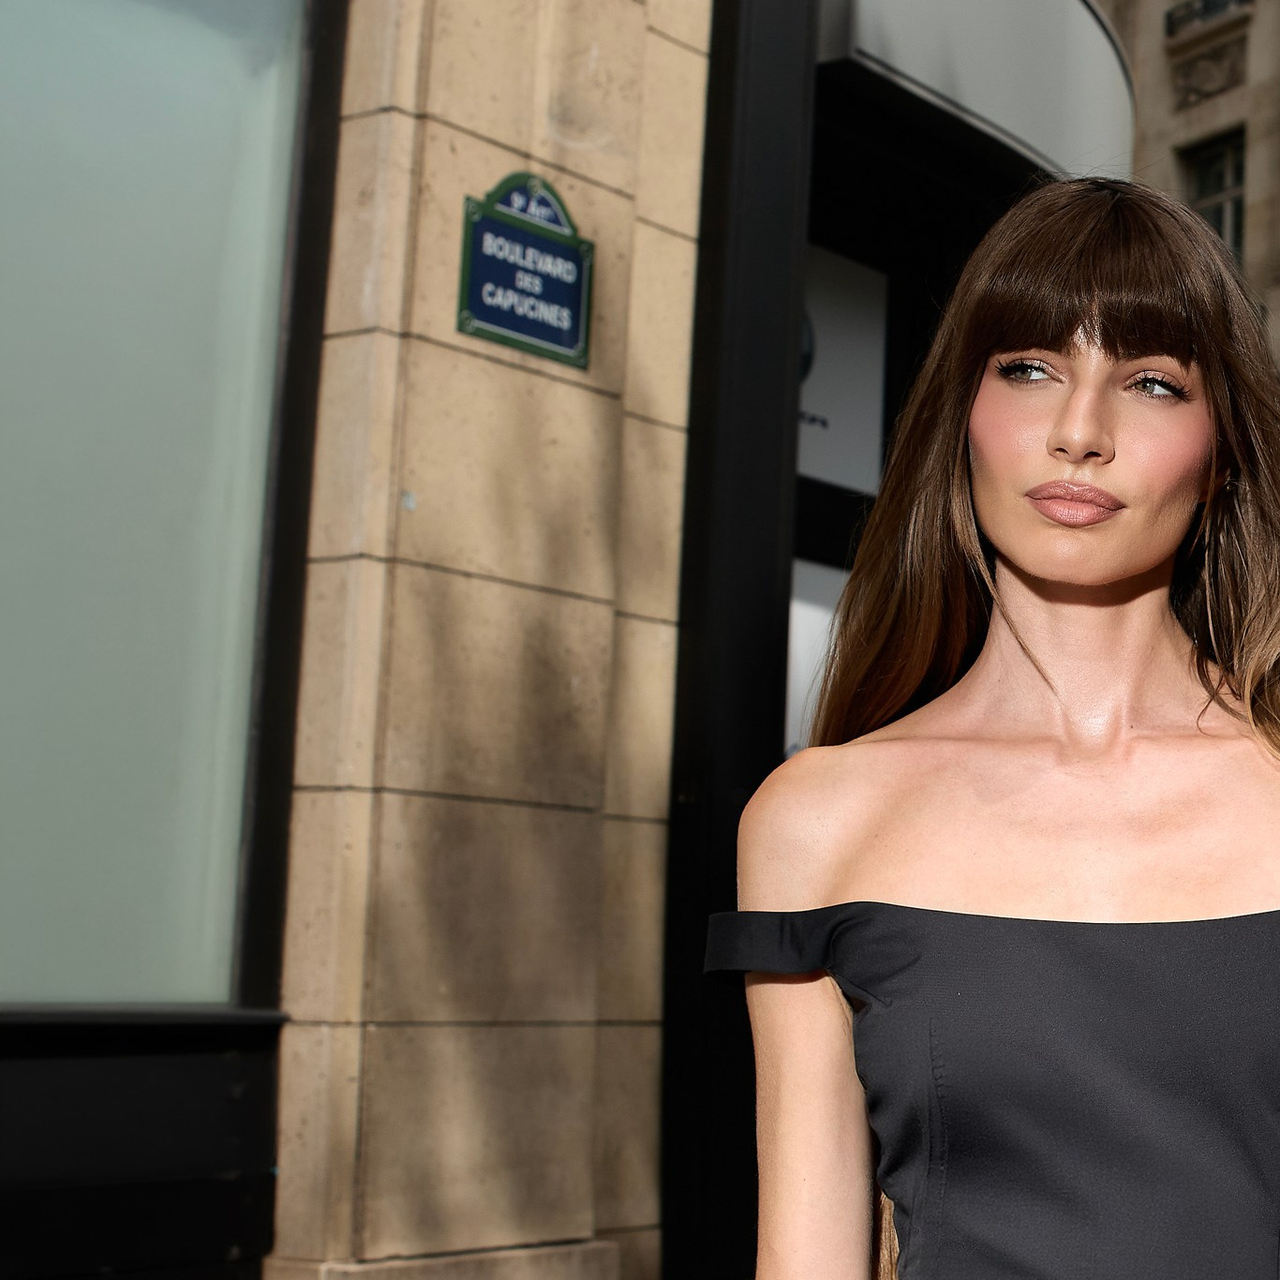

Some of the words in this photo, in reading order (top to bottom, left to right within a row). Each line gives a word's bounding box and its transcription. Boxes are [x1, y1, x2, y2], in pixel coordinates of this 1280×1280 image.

[482, 231, 578, 284] BOULEVARD
[482, 282, 572, 331] CAPUCINES
[515, 270, 543, 295] DES
